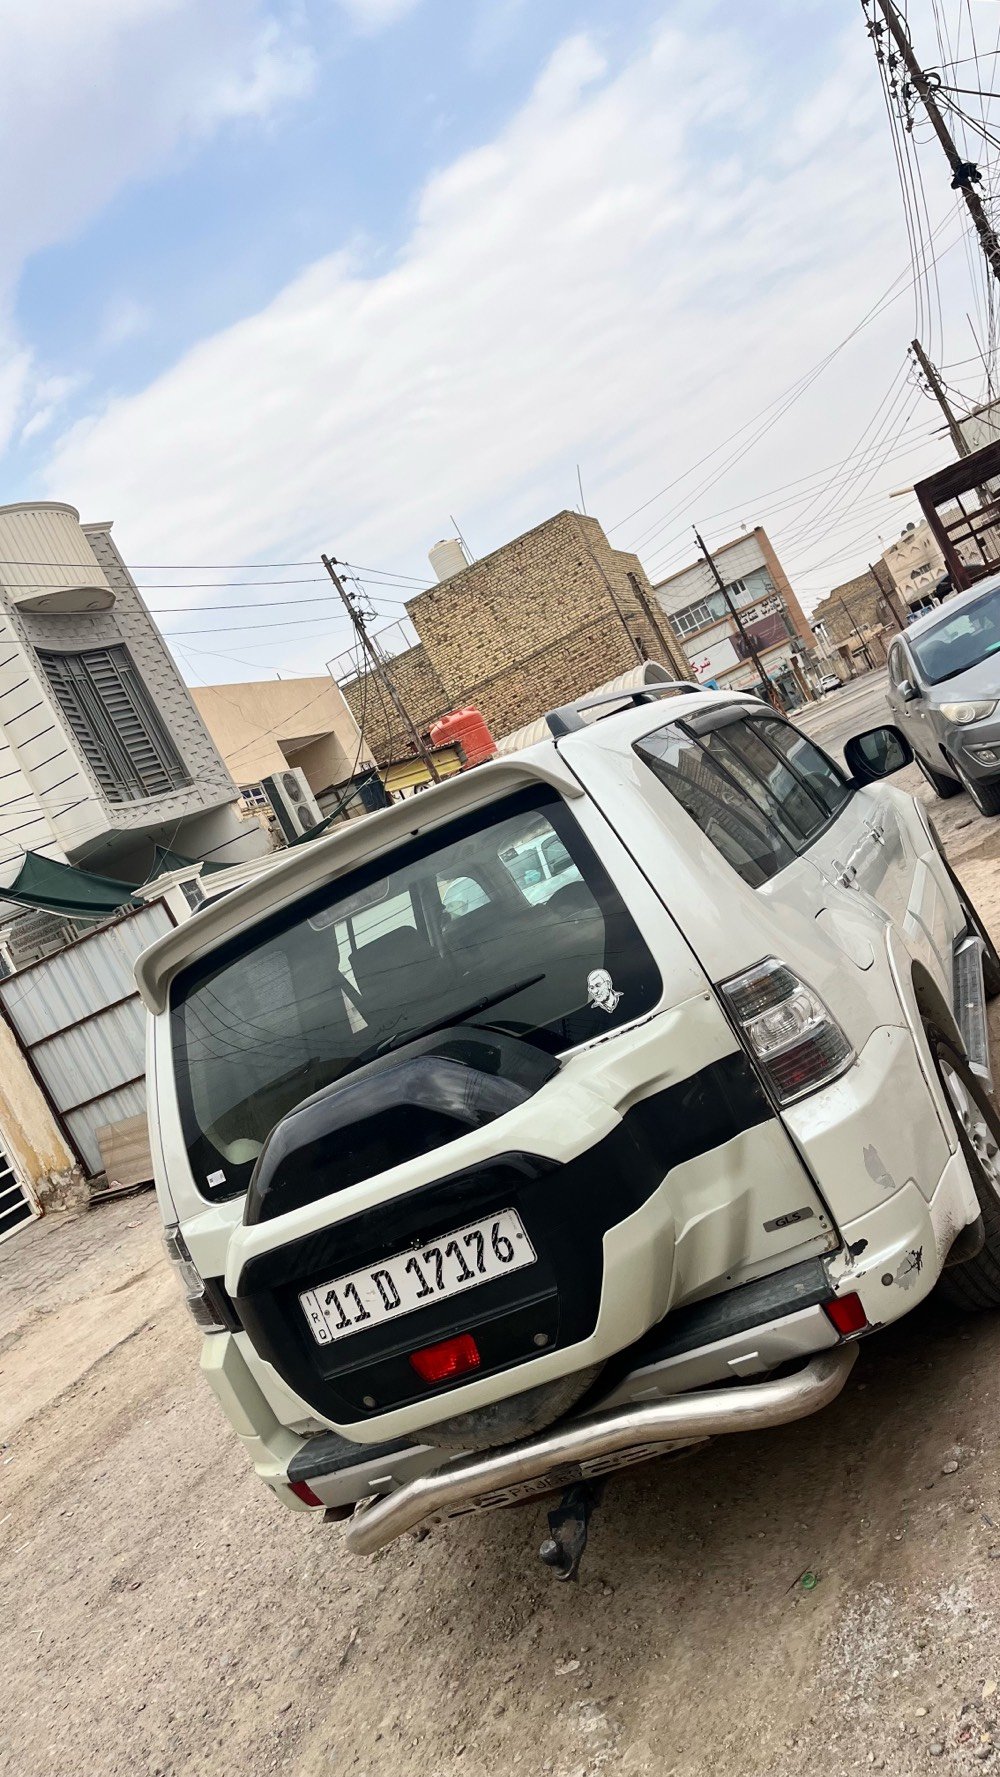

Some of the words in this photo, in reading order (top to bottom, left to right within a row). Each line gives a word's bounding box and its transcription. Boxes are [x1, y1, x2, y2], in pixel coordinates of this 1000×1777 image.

[775, 1212, 802, 1227] GLS
[325, 1282, 371, 1330] 11
[370, 1269, 401, 1311] D
[405, 1222, 515, 1299] 17176
